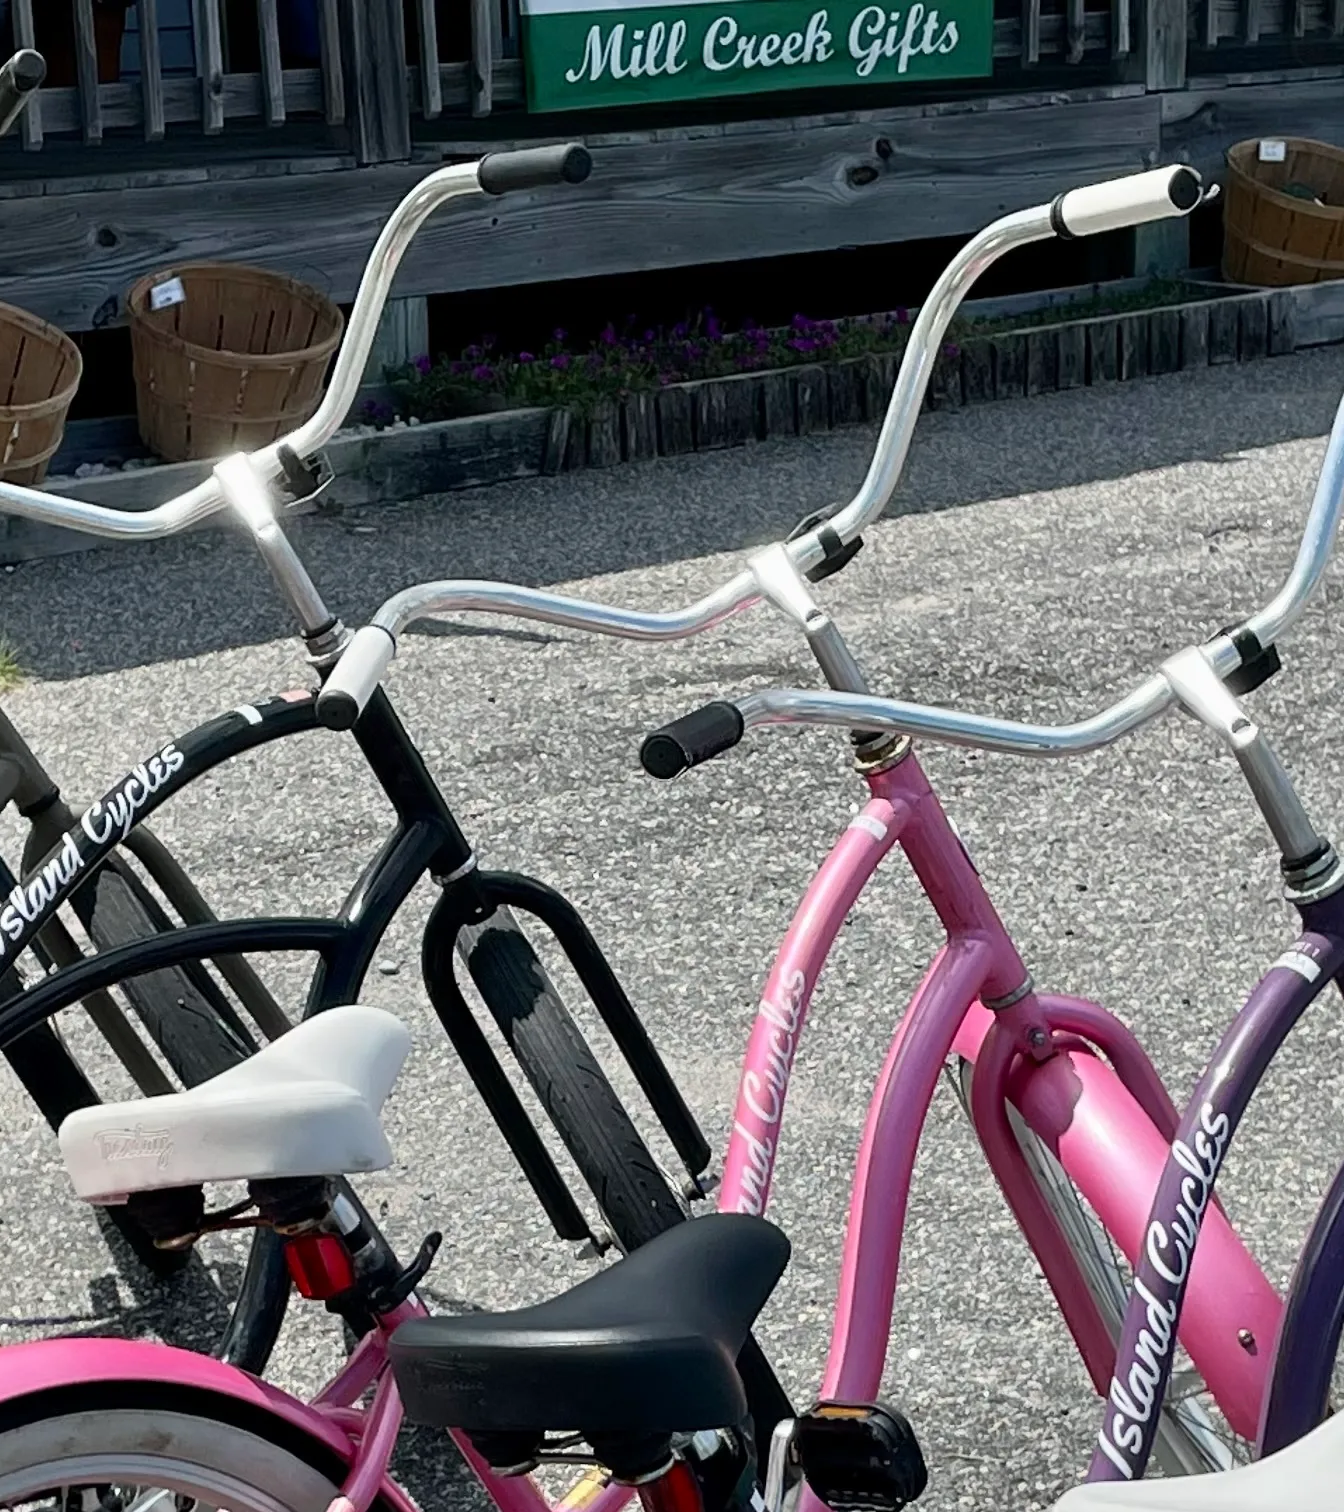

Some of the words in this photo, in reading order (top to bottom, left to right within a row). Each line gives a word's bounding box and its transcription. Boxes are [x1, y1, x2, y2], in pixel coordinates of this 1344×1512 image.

[566, 19, 688, 83] Mill
[702, 10, 834, 73] Creek
[848, 3, 960, 77] Gifts
[81, 743, 185, 845] Cycles
[1097, 1276, 1176, 1480] Island
[1146, 1102, 1229, 1285] Cycles
